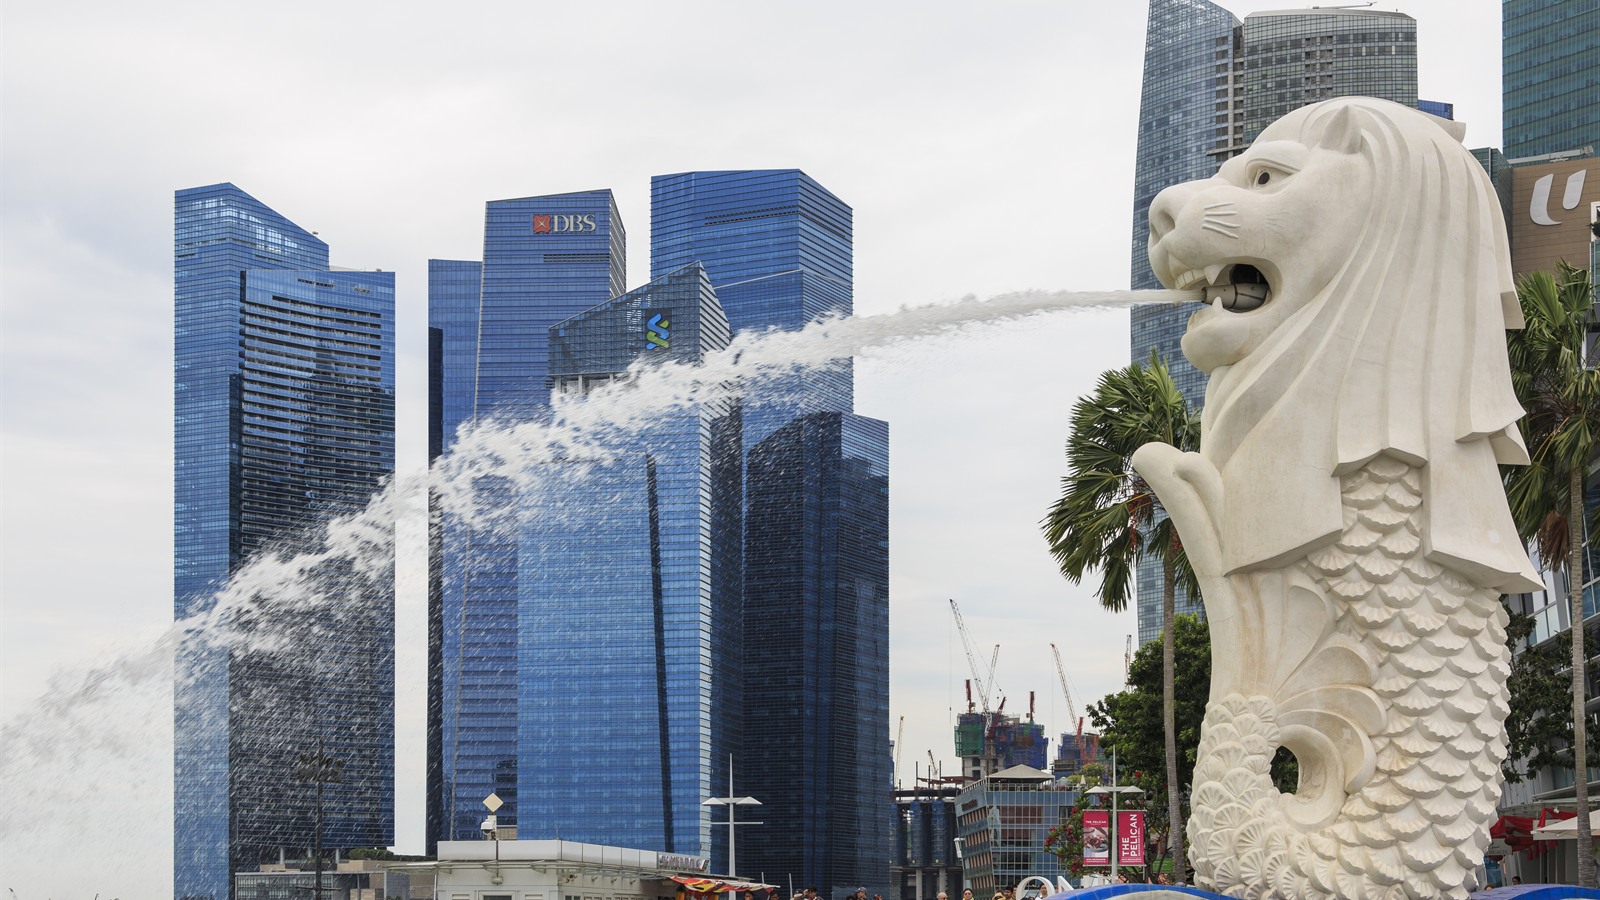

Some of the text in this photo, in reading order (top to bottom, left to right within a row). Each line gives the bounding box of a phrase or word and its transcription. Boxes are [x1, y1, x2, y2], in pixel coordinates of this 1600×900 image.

[553, 214, 596, 232] DBS
[1130, 814, 1138, 857] PELICAN
[1122, 837, 1130, 857] THE
